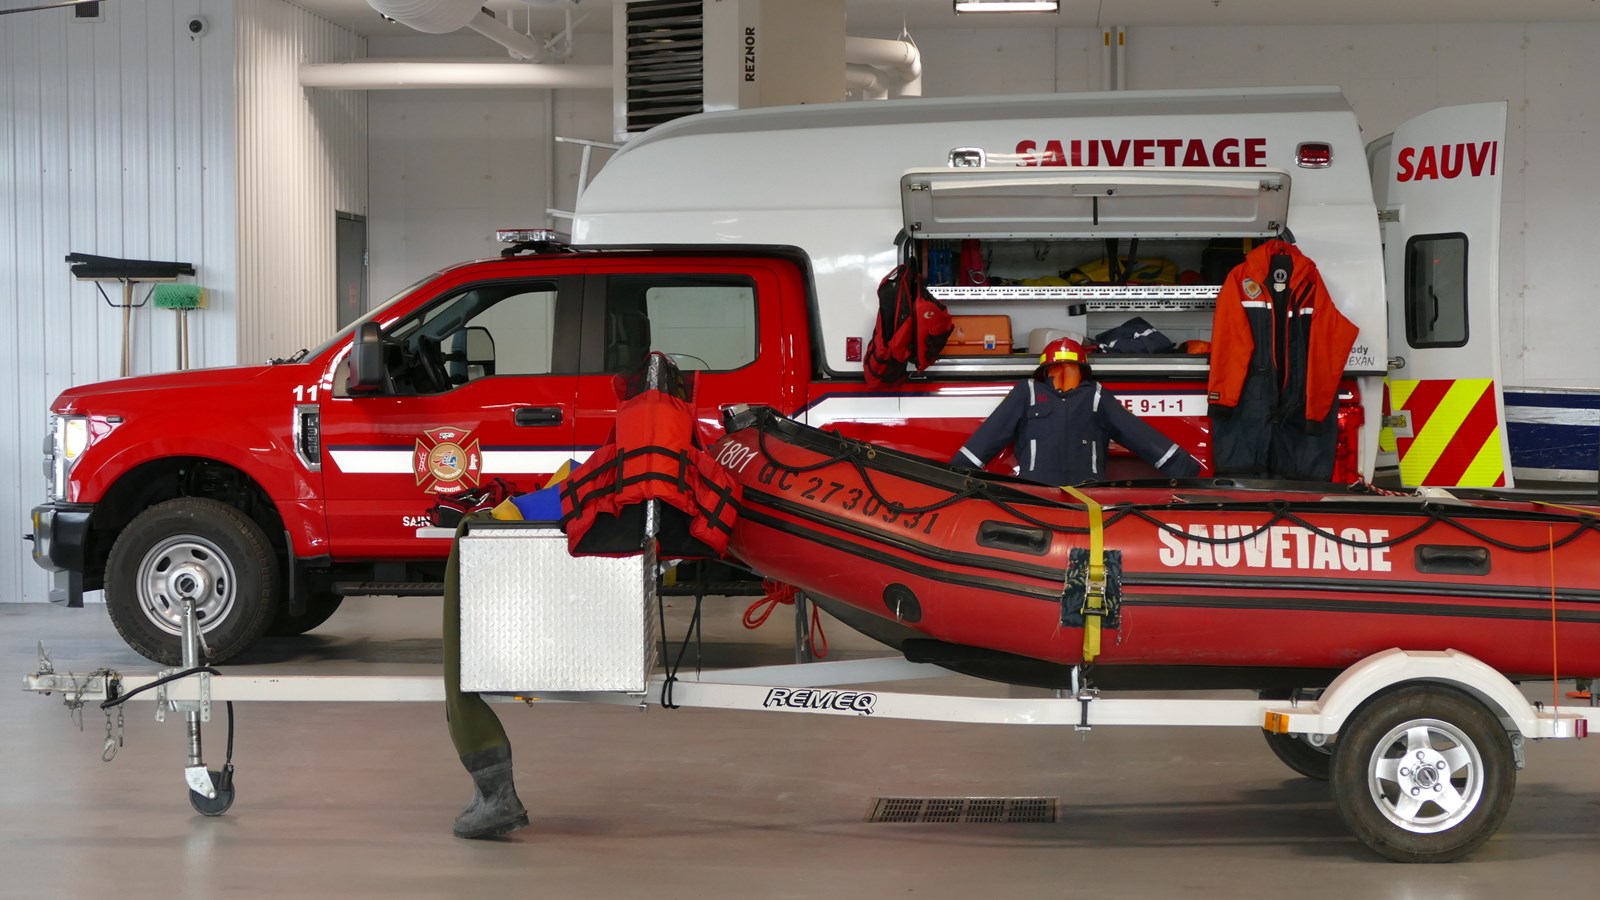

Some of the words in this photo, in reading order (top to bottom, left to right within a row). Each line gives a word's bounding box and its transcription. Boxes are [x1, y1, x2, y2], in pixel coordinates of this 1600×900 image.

[745, 27, 755, 81] REZNOR
[1015, 138, 1267, 168] SAUVETAGE
[1347, 356, 1375, 367] EXAN
[1351, 345, 1369, 355] ody
[292, 385, 318, 401] 11
[1116, 399, 1133, 413] E
[1140, 399, 1183, 412] 9-1-1
[715, 440, 759, 473] 1801
[758, 463, 798, 491] QC
[402, 516, 431, 527] SAIN
[1158, 523, 1392, 572] SAUVETAGE
[763, 688, 877, 715] REMEQ
